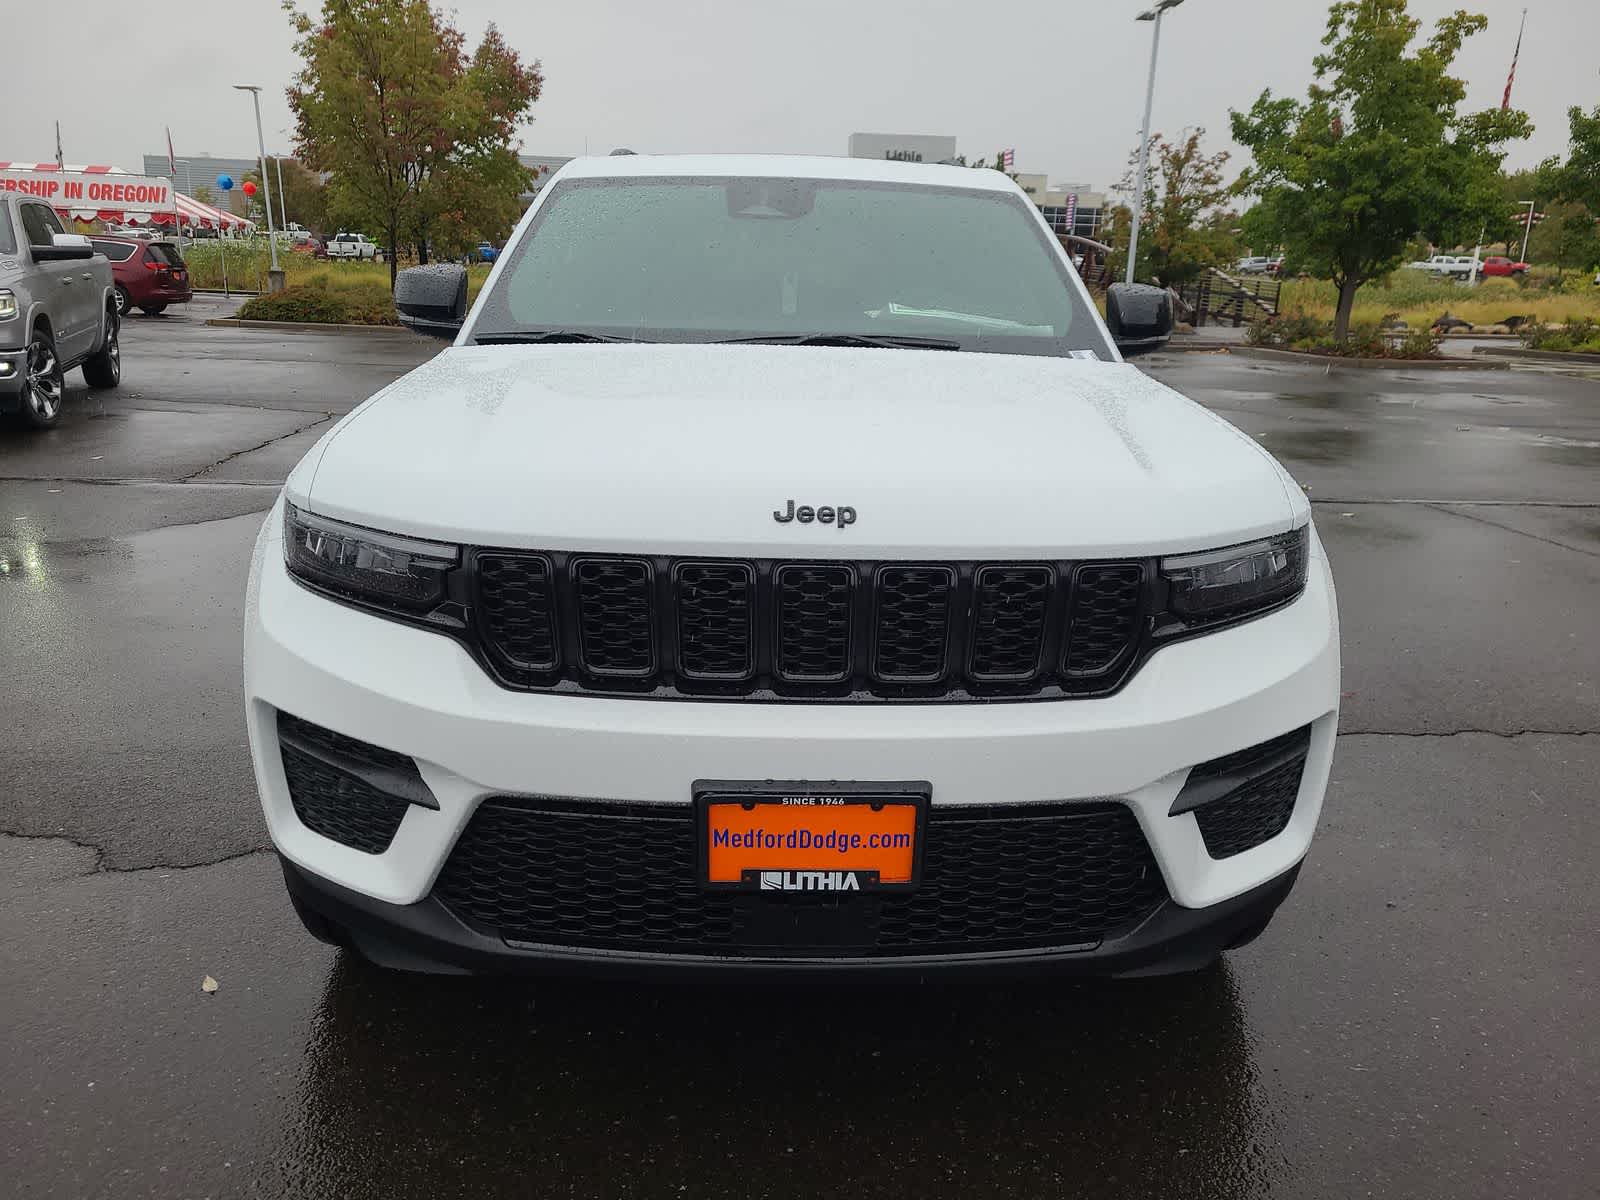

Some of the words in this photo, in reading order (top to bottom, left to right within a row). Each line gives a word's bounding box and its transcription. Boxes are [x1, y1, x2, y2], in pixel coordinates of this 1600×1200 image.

[64, 181, 83, 200] IN
[88, 183, 167, 204] OREGON!
[773, 499, 857, 529] Jeep
[782, 797, 816, 806] SINCE
[820, 797, 845, 806] 1946
[713, 828, 911, 853] MedfordDodge.com
[783, 871, 860, 891] LITHIA
